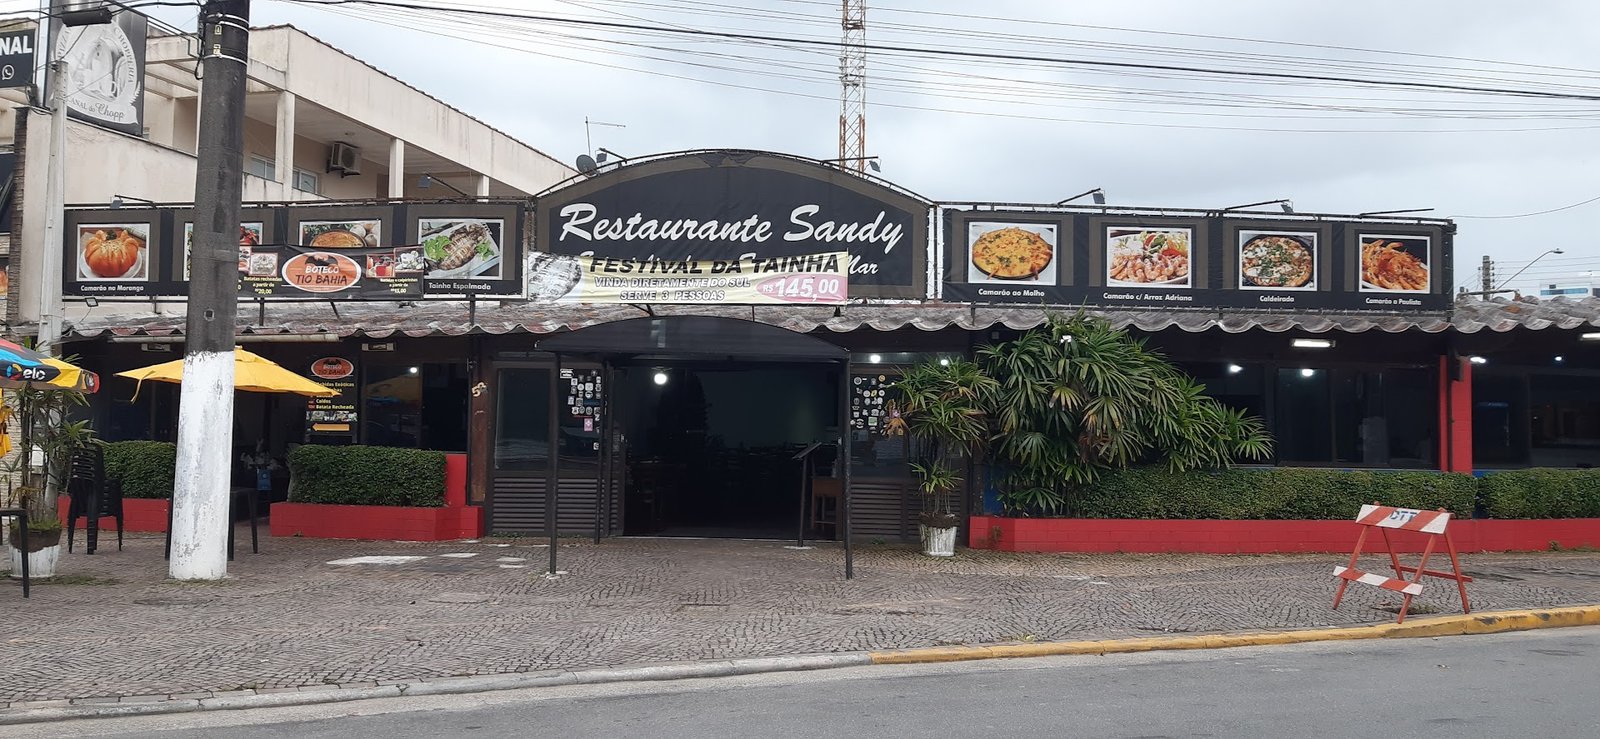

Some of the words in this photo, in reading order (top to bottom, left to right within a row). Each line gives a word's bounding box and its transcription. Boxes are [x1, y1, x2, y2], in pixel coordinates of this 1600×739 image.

[95, 102, 126, 122] Chopp
[559, 203, 773, 243] Restaurante
[783, 204, 904, 255] Sandy
[305, 265, 339, 274] BOTECO
[590, 256, 703, 274] FESTIVAL
[711, 260, 742, 274] DA
[753, 254, 839, 274] TAINHA
[295, 274, 313, 285] TIO
[315, 275, 348, 286] BAHIA
[594, 277, 629, 288] VINDA
[631, 277, 709, 288] DIRETAMENTE
[709, 277, 727, 288] DO
[727, 277, 751, 288] SUL
[774, 278, 839, 301] 145,00
[978, 288, 1011, 296] Camarão
[1023, 289, 1045, 297] Molho
[620, 291, 657, 301] SERVE
[661, 290, 669, 301] 3
[674, 290, 726, 301] PESSOAS
[1103, 292, 1134, 300] Camarão
[1259, 295, 1295, 303] Caldeirada
[1365, 297, 1392, 305] Camarão
[1398, 298, 1422, 306] Paulista
[23, 367, 46, 380] elo
